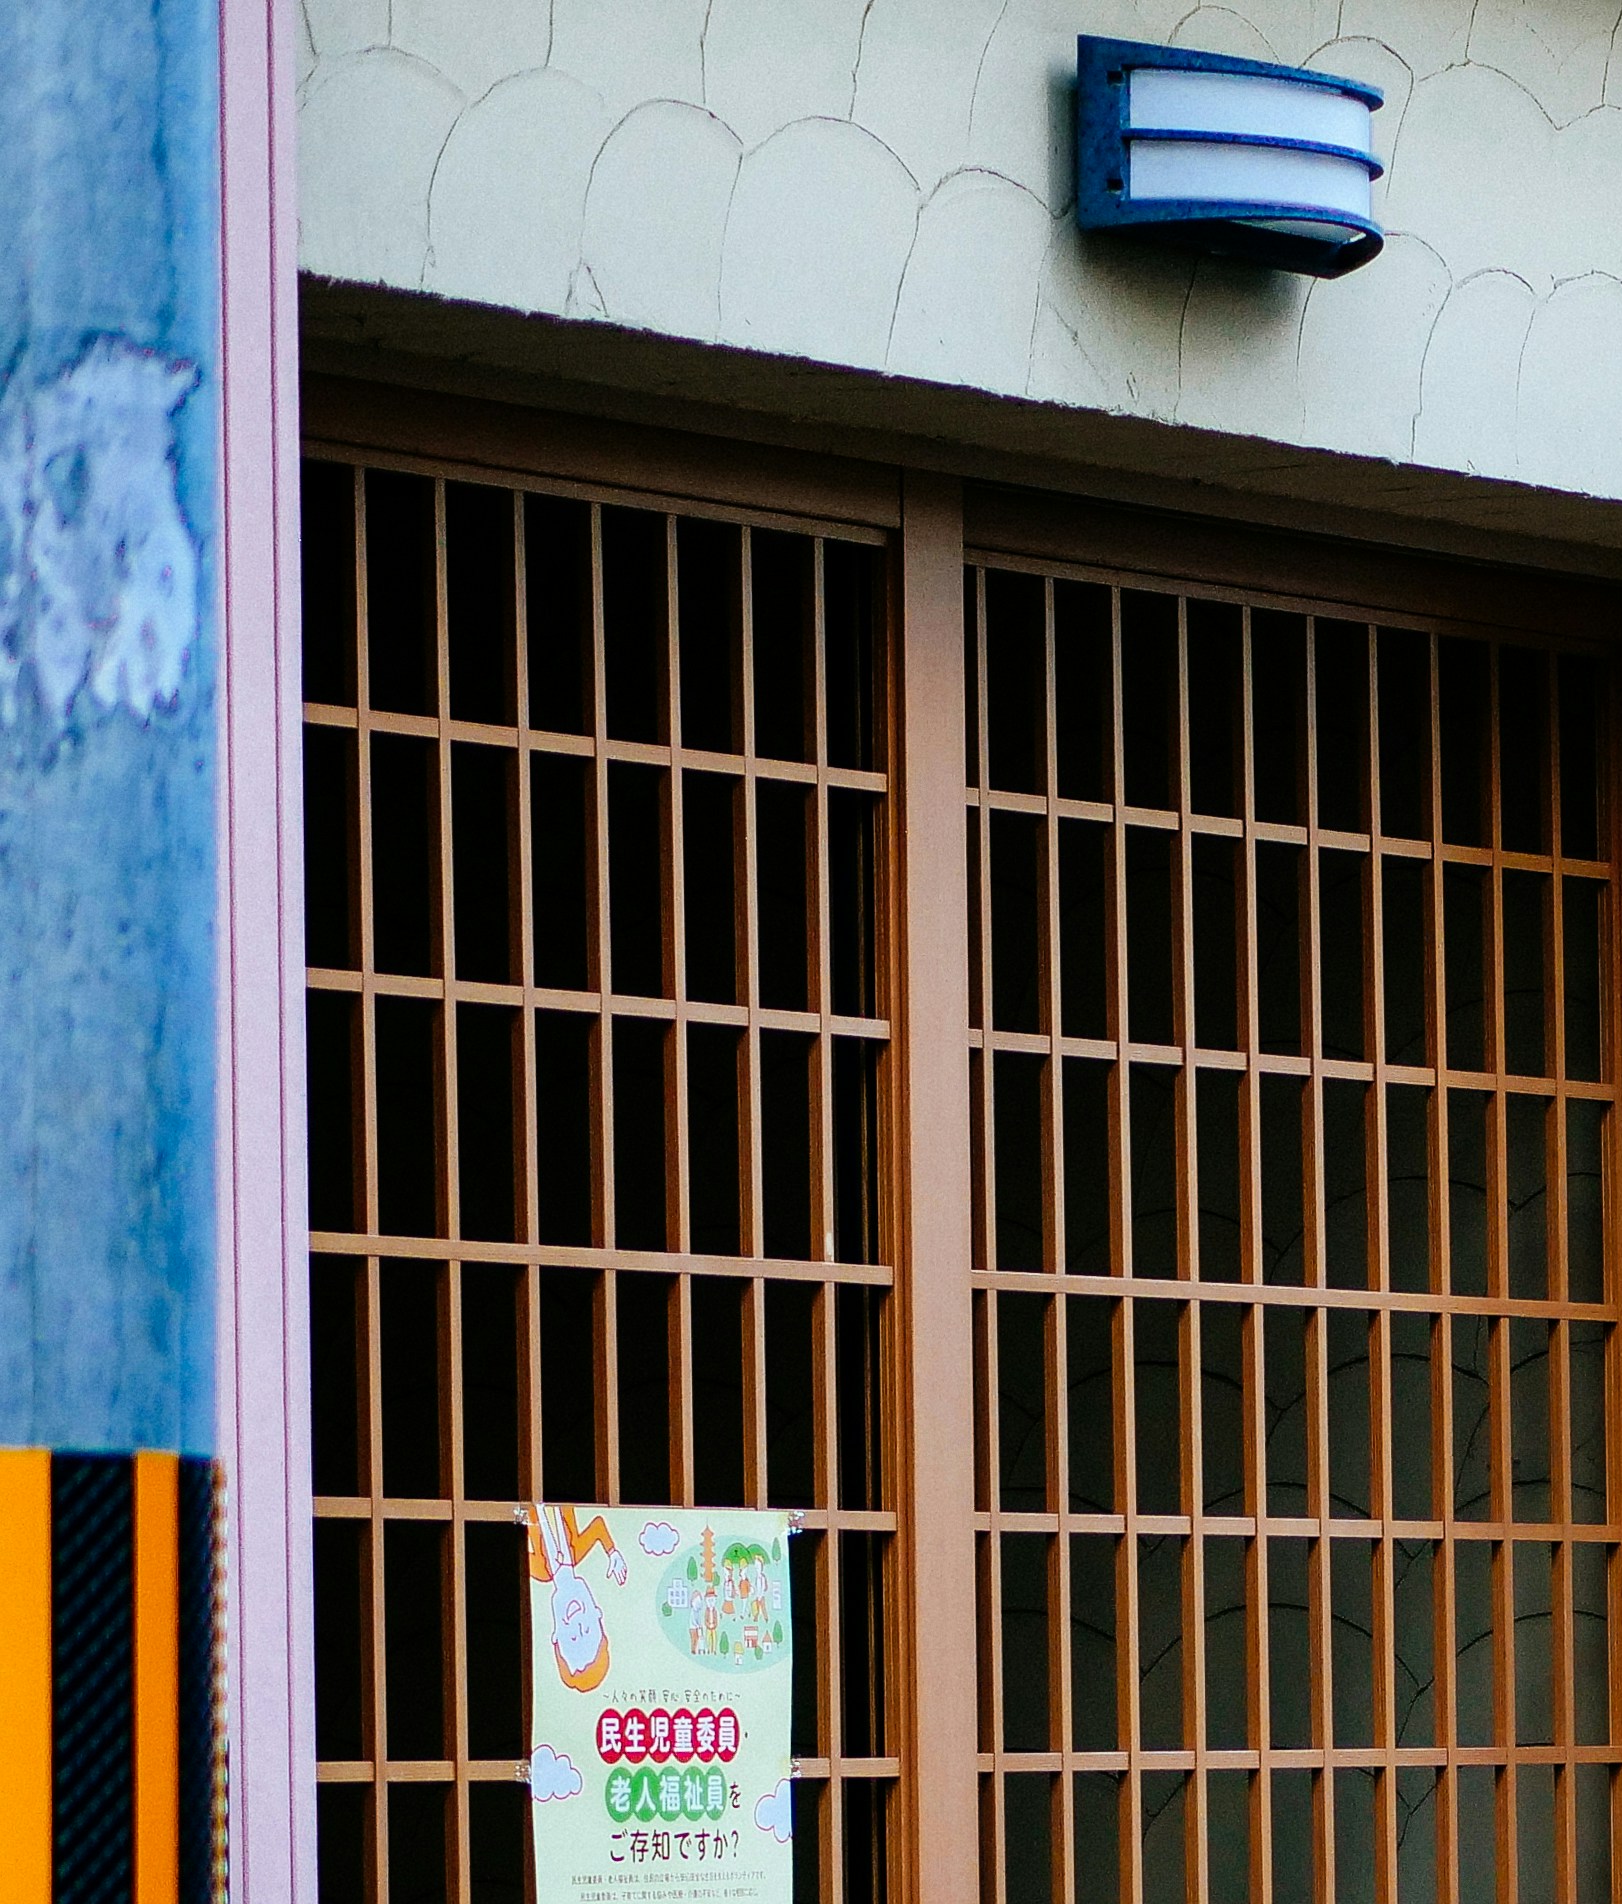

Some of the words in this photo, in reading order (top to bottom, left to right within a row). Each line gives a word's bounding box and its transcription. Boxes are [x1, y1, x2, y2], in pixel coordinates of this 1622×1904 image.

[610, 1775, 741, 1812] 老人福祉員を
[610, 1828, 739, 1863] ご存知ですか?
